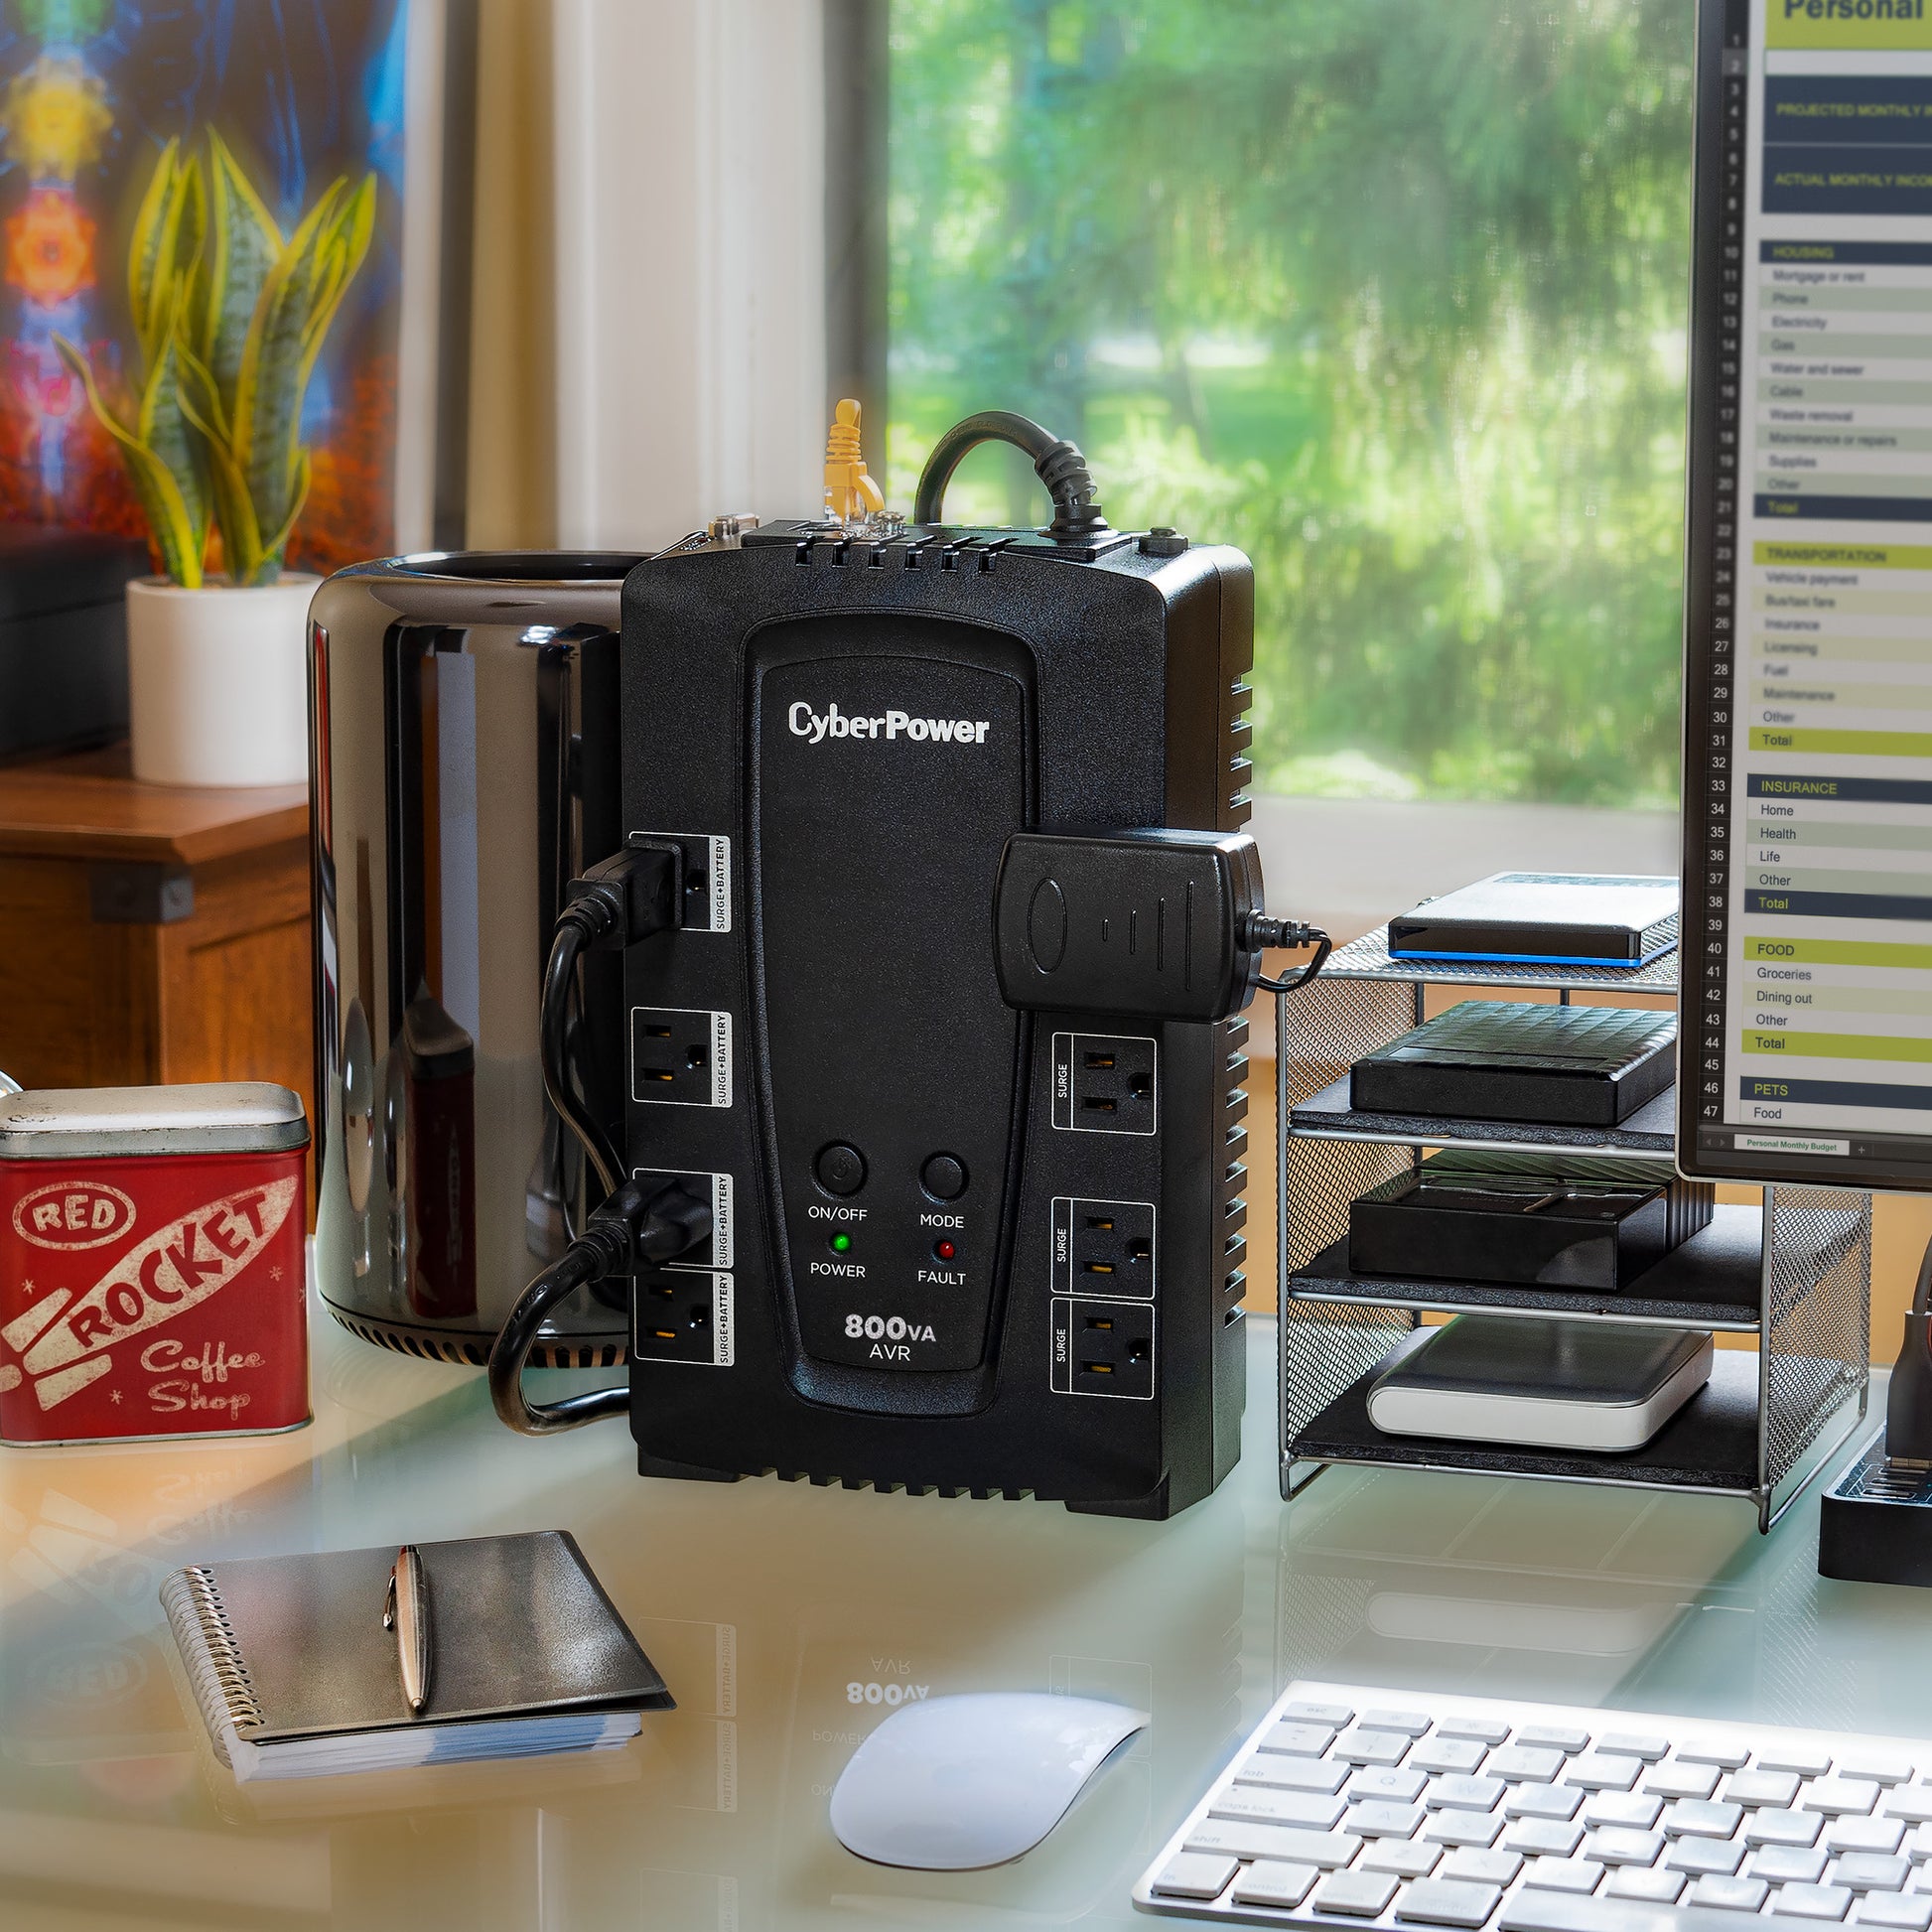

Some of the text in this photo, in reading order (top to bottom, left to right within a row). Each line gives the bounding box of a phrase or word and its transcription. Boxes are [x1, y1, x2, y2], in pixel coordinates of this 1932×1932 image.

[1782, 0, 1925, 20] Personal
[1731, 61, 1739, 71] 2
[1731, 83, 1739, 95] 3
[1730, 106, 1738, 116] 4
[1776, 105, 1855, 117] PROJECTED
[1858, 105, 1919, 117] MONTHLY
[1730, 128, 1738, 140] 5
[1729, 153, 1737, 165] 6
[1729, 174, 1737, 186] 7
[1775, 175, 1826, 187] ACTUAL
[1830, 175, 1892, 187] MONTHLY
[1728, 198, 1736, 209] 8
[1727, 223, 1736, 235] 9
[1725, 246, 1739, 259] 10
[1773, 246, 1834, 259] HOUSING
[1724, 270, 1737, 281] 11
[1773, 270, 1864, 283] Mortgage or rent
[1724, 293, 1737, 306] 12
[1772, 292, 1809, 305] Phone
[1724, 316, 1737, 329] 13
[1771, 316, 1827, 331] Electricity
[1723, 340, 1735, 350] 14
[1771, 339, 1795, 351] Gas
[1722, 362, 1735, 374] 15
[1771, 363, 1863, 375] Water and sewer
[1722, 385, 1735, 397] 16
[1770, 385, 1803, 398] Cable
[1721, 408, 1734, 420] 17
[1770, 410, 1853, 422] Waste removal
[1721, 432, 1733, 444] 18
[1769, 433, 1896, 448] Maintenance or repairs
[1721, 455, 1733, 467] 19
[1769, 455, 1817, 469] Supplies
[1719, 479, 1732, 489] 20
[1768, 479, 1800, 490] Other
[1718, 500, 1731, 513] 21
[1768, 500, 1798, 514] Total
[1718, 524, 1731, 536] 22
[1717, 547, 1731, 560] 23
[1766, 547, 1887, 564] TRANSPORTATION
[1716, 571, 1730, 583] 24
[1766, 572, 1858, 588] Vehicle payment
[1716, 594, 1729, 606] 25
[1813, 597, 1835, 608] fare
[1716, 618, 1729, 628] 26
[1765, 619, 1821, 631] Insurance
[1715, 640, 1728, 651] 27
[1764, 641, 1818, 657] Licensing
[1715, 664, 1727, 675] 28
[1763, 664, 1789, 676] Fuel
[1714, 687, 1727, 698] 29
[1763, 687, 1836, 701] Maintenance
[788, 701, 990, 744] CyberPower
[1714, 712, 1726, 723] 30
[1763, 711, 1795, 723] Other
[1713, 735, 1725, 746] 31
[1762, 734, 1792, 747] Total
[1713, 757, 1725, 767] 32
[1712, 780, 1725, 791] 33
[1762, 780, 1837, 794] INSURANCE
[1712, 803, 1725, 814] 34
[1761, 804, 1793, 816] Home
[1711, 826, 1725, 838] 35
[1760, 827, 1796, 839] Health
[1711, 850, 1724, 861] 36
[1760, 851, 1780, 862] Life
[716, 838, 725, 930] SURGE+BATTERY
[1710, 873, 1723, 884] 37
[1759, 874, 1791, 886] Other
[1709, 897, 1723, 907] 38
[1758, 897, 1788, 908] Total
[1709, 919, 1722, 930] 39
[1708, 943, 1722, 954] 40
[1758, 944, 1794, 956] FOOD
[1707, 966, 1720, 977] 41
[1757, 967, 1811, 980] Groceries
[1707, 989, 1721, 1000] 42
[1756, 992, 1812, 1005] Dining out
[1706, 1014, 1720, 1025] 43
[1756, 1014, 1788, 1026] Other
[1706, 1037, 1719, 1048] 44
[1755, 1036, 1785, 1048] Total
[717, 1015, 727, 1106] SURGE+BATTERY
[1705, 1059, 1719, 1070] 45
[1058, 1062, 1068, 1098] SURGE
[1705, 1082, 1718, 1093] 46
[1755, 1083, 1788, 1096] PETS
[1704, 1106, 1718, 1117] 47
[1754, 1107, 1781, 1119] Food
[1747, 1139, 1837, 1152] Personal Monthly Budget
[32, 1193, 117, 1232] RED
[808, 1206, 868, 1222] ON/OFF
[719, 1176, 728, 1267] SURGE+BATTERY
[919, 1213, 965, 1229] MODE
[1056, 1227, 1066, 1263] SURGE
[67, 1192, 270, 1348] ROCKET
[810, 1262, 867, 1279] POWER
[917, 1270, 966, 1286] FAULT
[720, 1274, 729, 1364] SURGE+BATTERY
[1056, 1327, 1066, 1363] SURGE
[869, 1344, 911, 1361] AVR
[140, 1339, 266, 1384] Coffee
[147, 1379, 251, 1421] Shop
